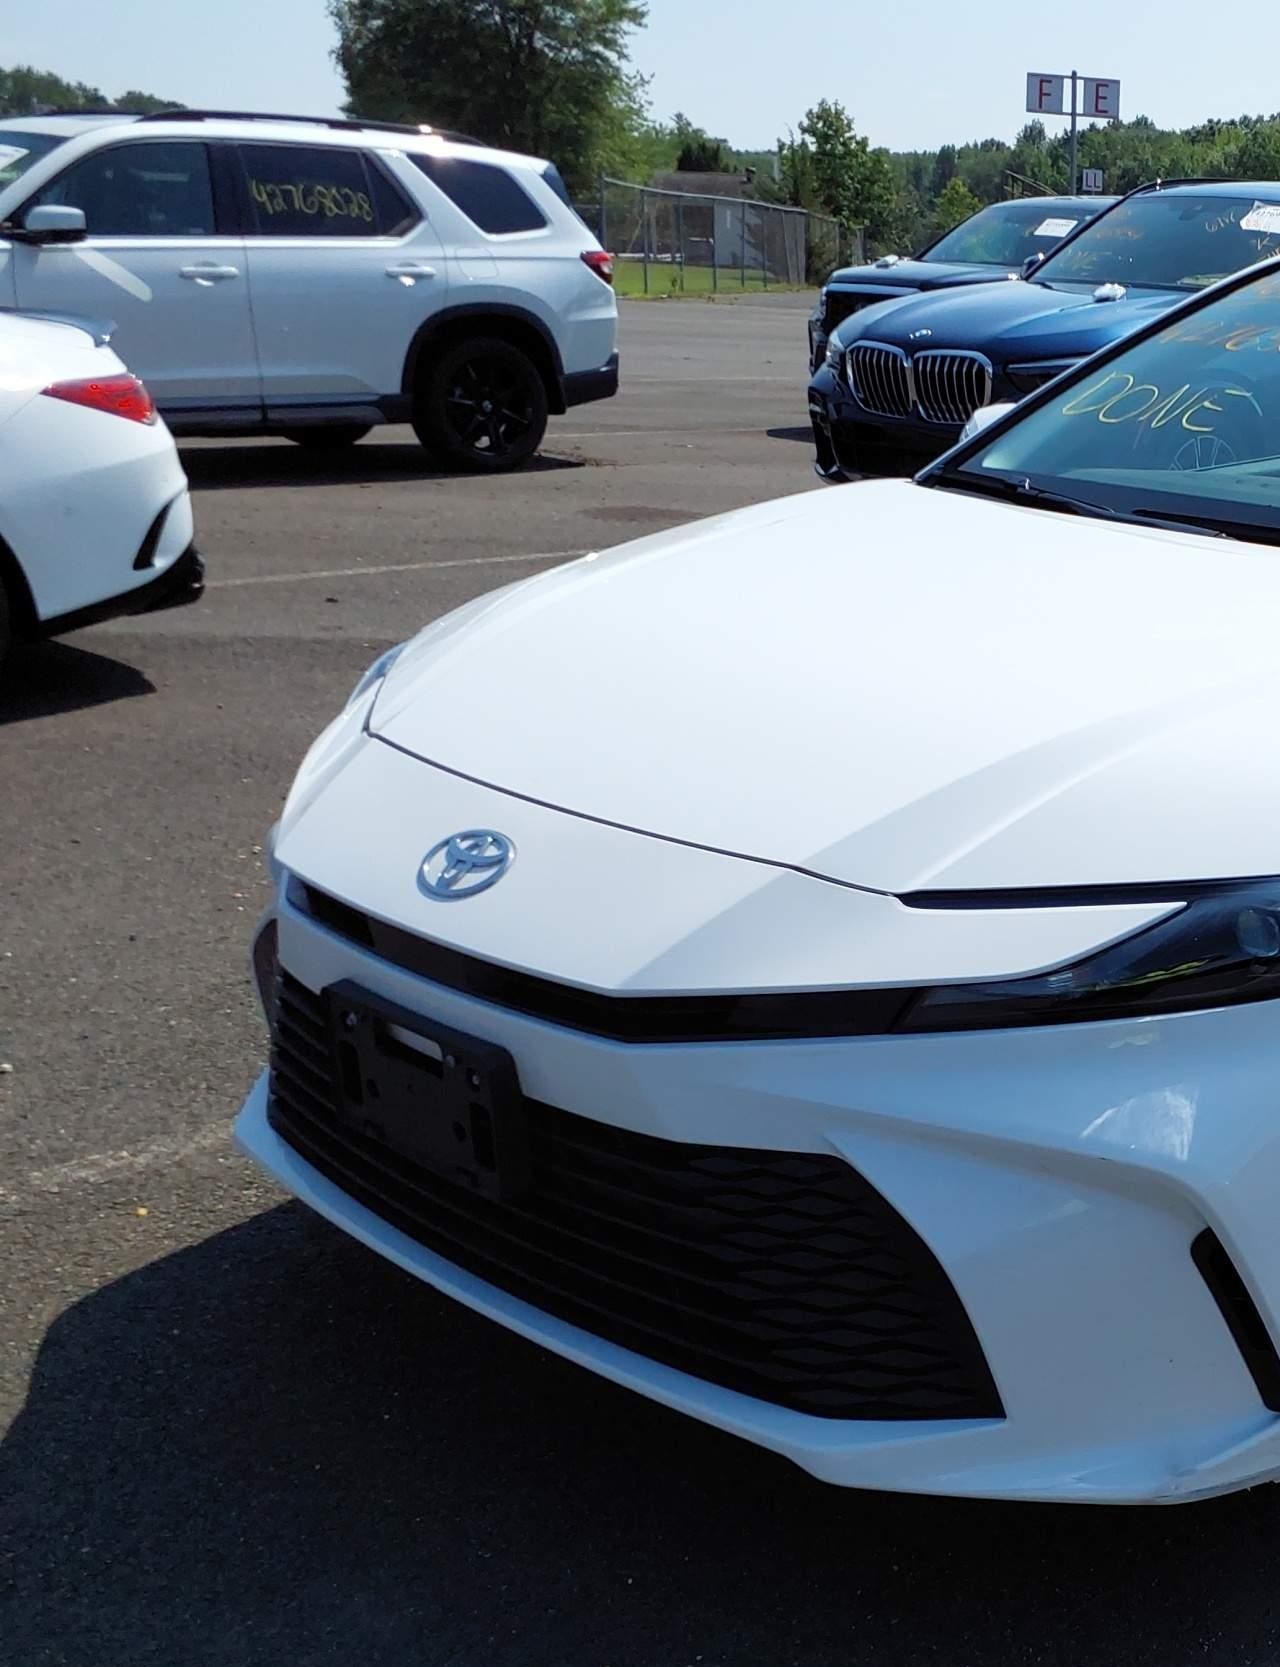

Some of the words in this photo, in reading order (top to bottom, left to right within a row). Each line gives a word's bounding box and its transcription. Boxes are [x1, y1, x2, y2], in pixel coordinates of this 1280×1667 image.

[1038, 78, 1053, 110] F
[1094, 82, 1109, 114] E
[1061, 371, 1256, 432] DONE
